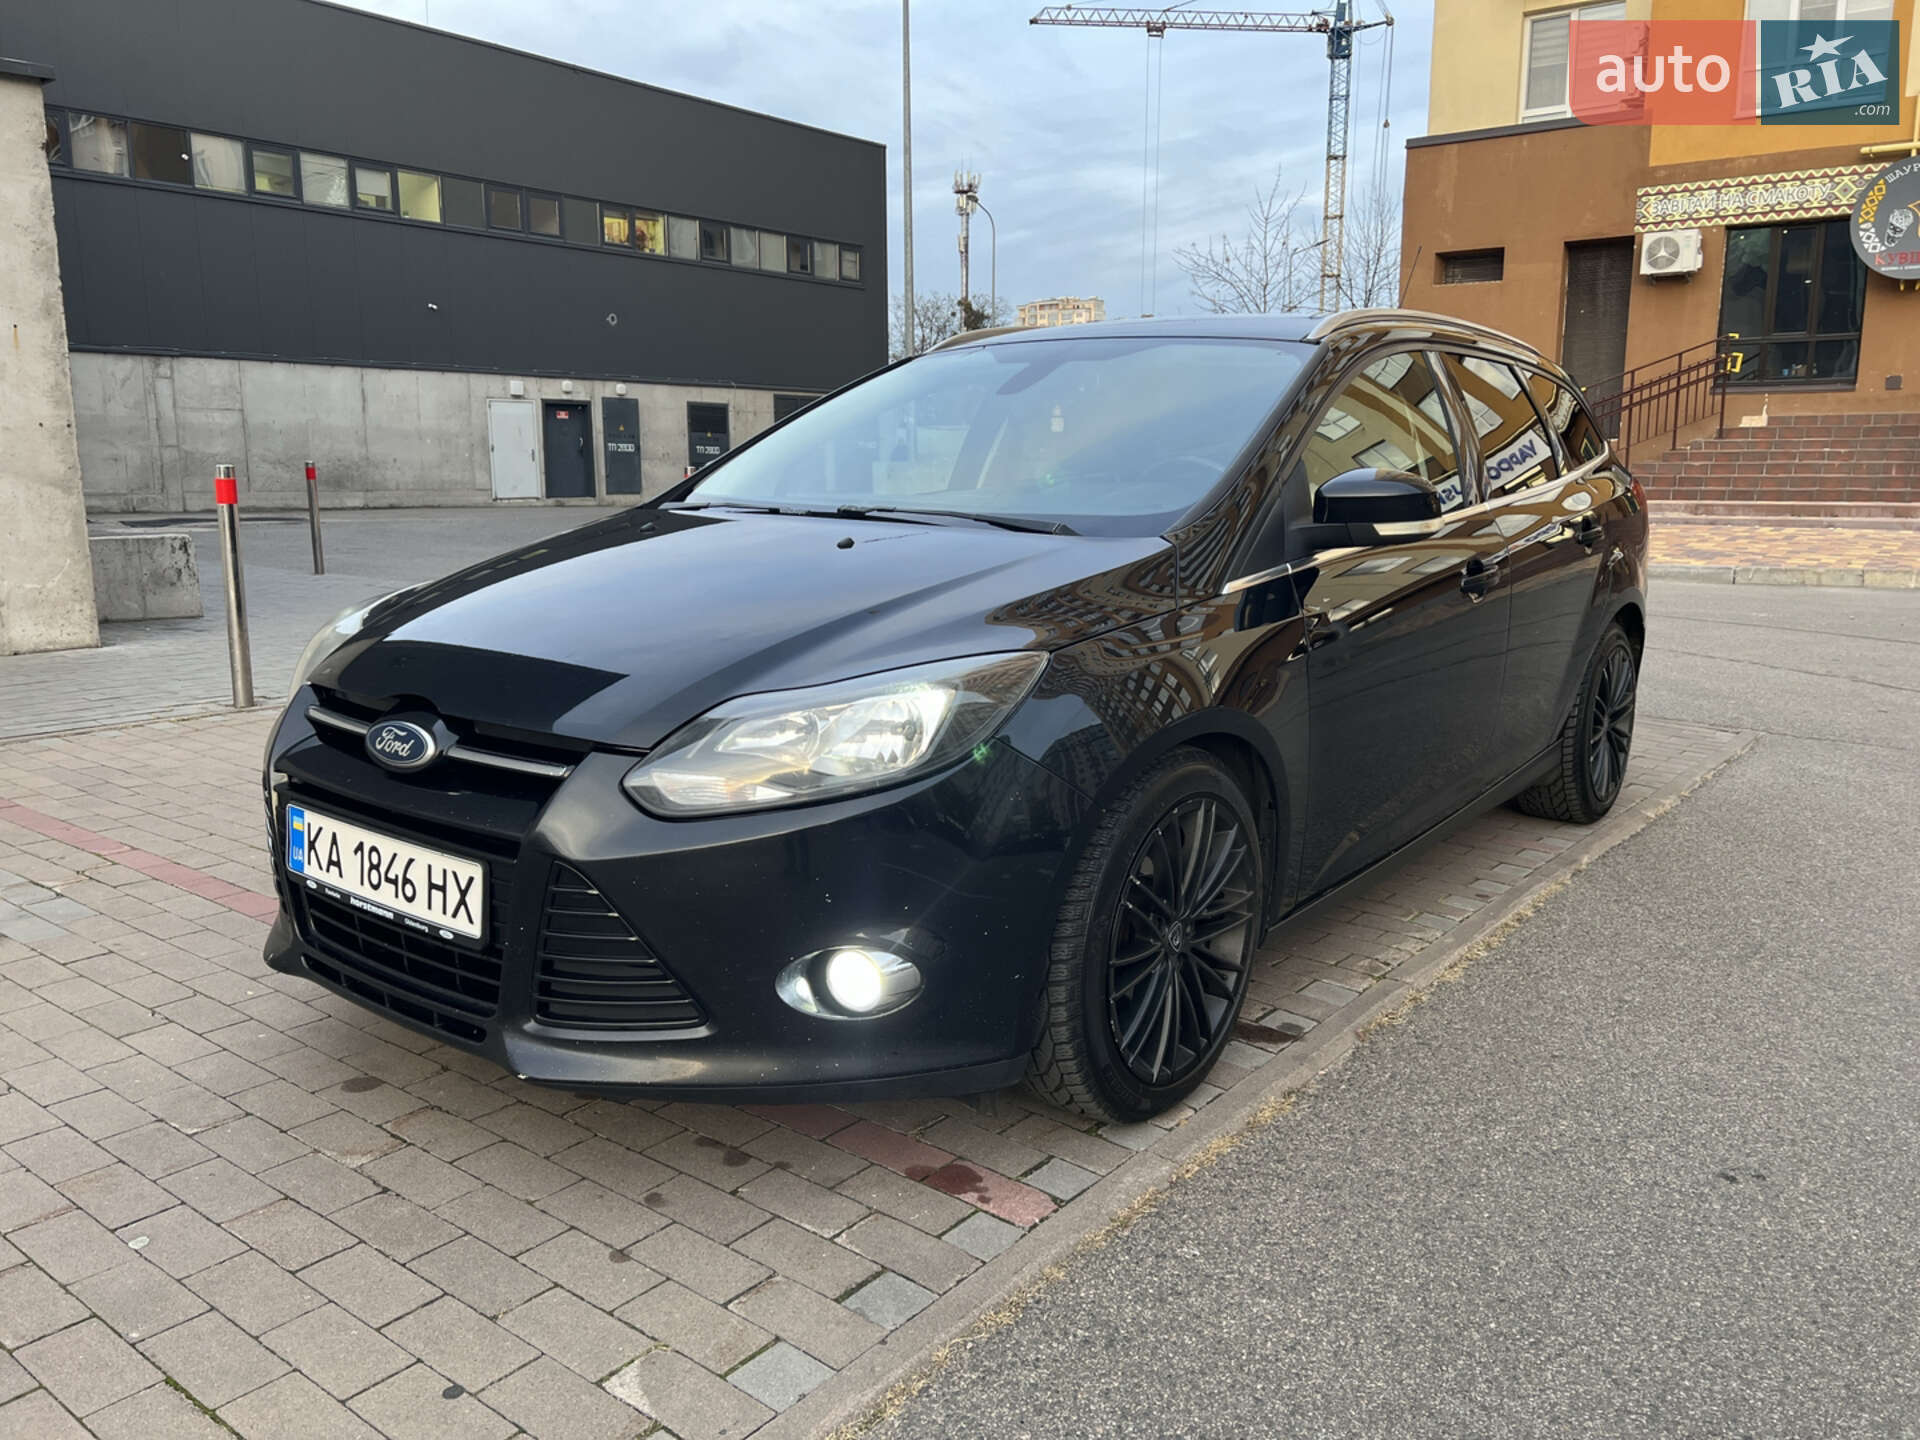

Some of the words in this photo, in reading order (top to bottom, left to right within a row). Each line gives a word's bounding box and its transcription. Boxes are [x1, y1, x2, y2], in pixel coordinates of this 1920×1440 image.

[1719, 191, 1744, 209] НА
[375, 726, 415, 757] Ford
[292, 846, 304, 863] UA
[306, 822, 343, 879] KA
[353, 840, 417, 904] 1846
[427, 863, 475, 925] HX
